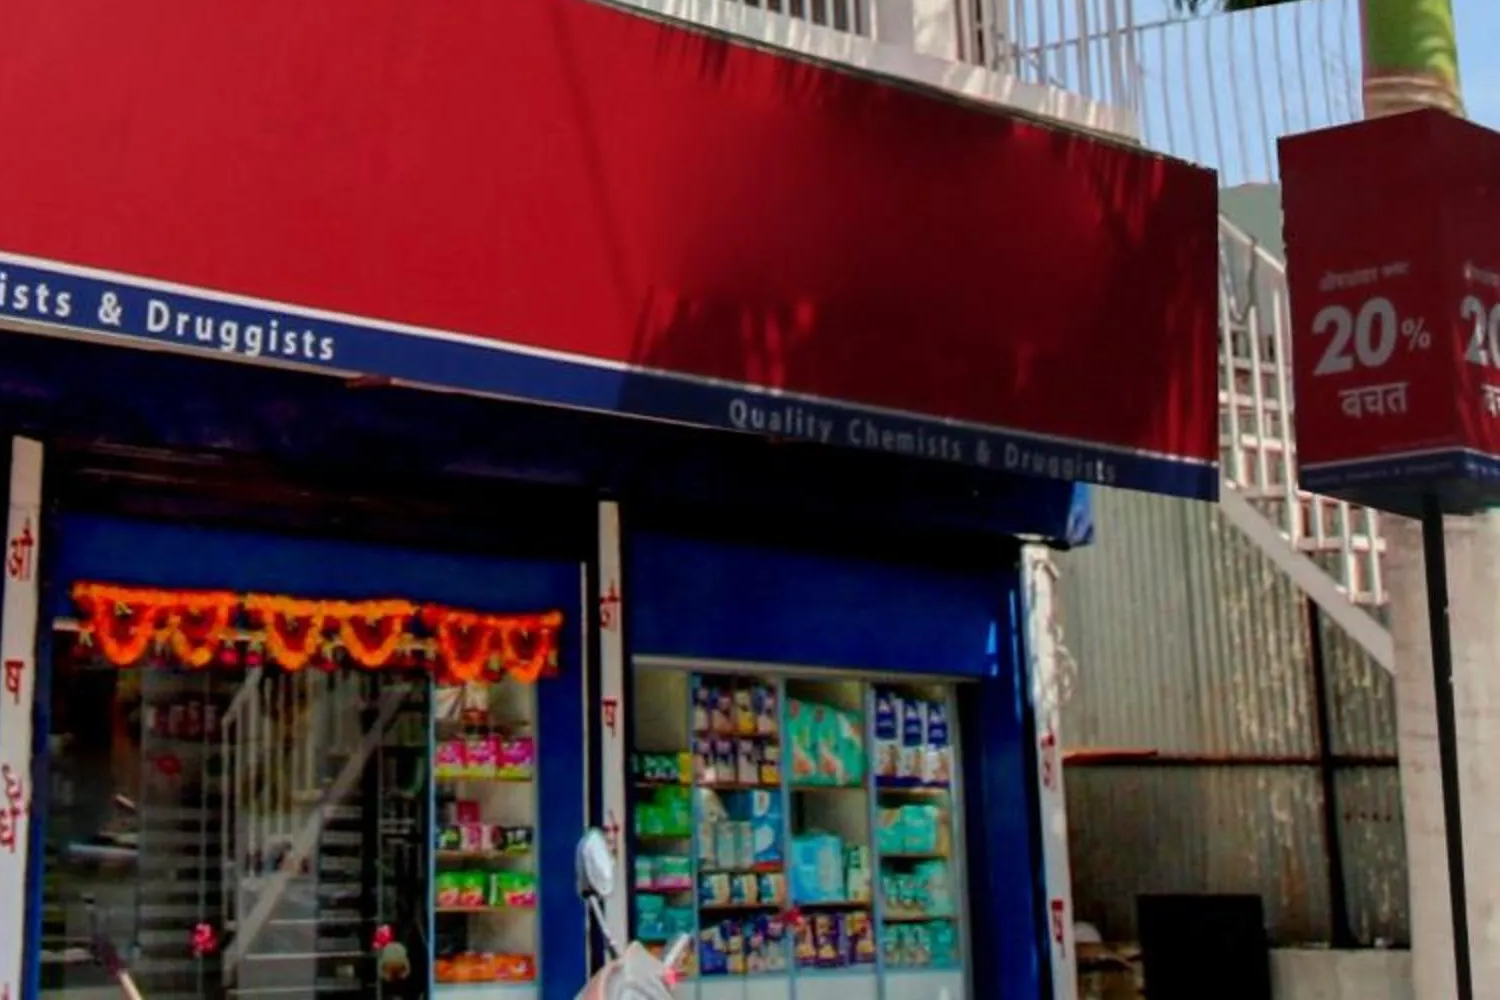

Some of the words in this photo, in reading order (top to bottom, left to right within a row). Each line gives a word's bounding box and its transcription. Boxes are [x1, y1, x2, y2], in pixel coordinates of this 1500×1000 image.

[97, 291, 122, 327] &
[147, 299, 335, 361] Druggists
[1311, 296, 1432, 376] 20%
[729, 398, 832, 443] Quality
[849, 418, 961, 461] Chemists
[976, 438, 991, 465] &
[1003, 442, 1115, 482] Druggists
